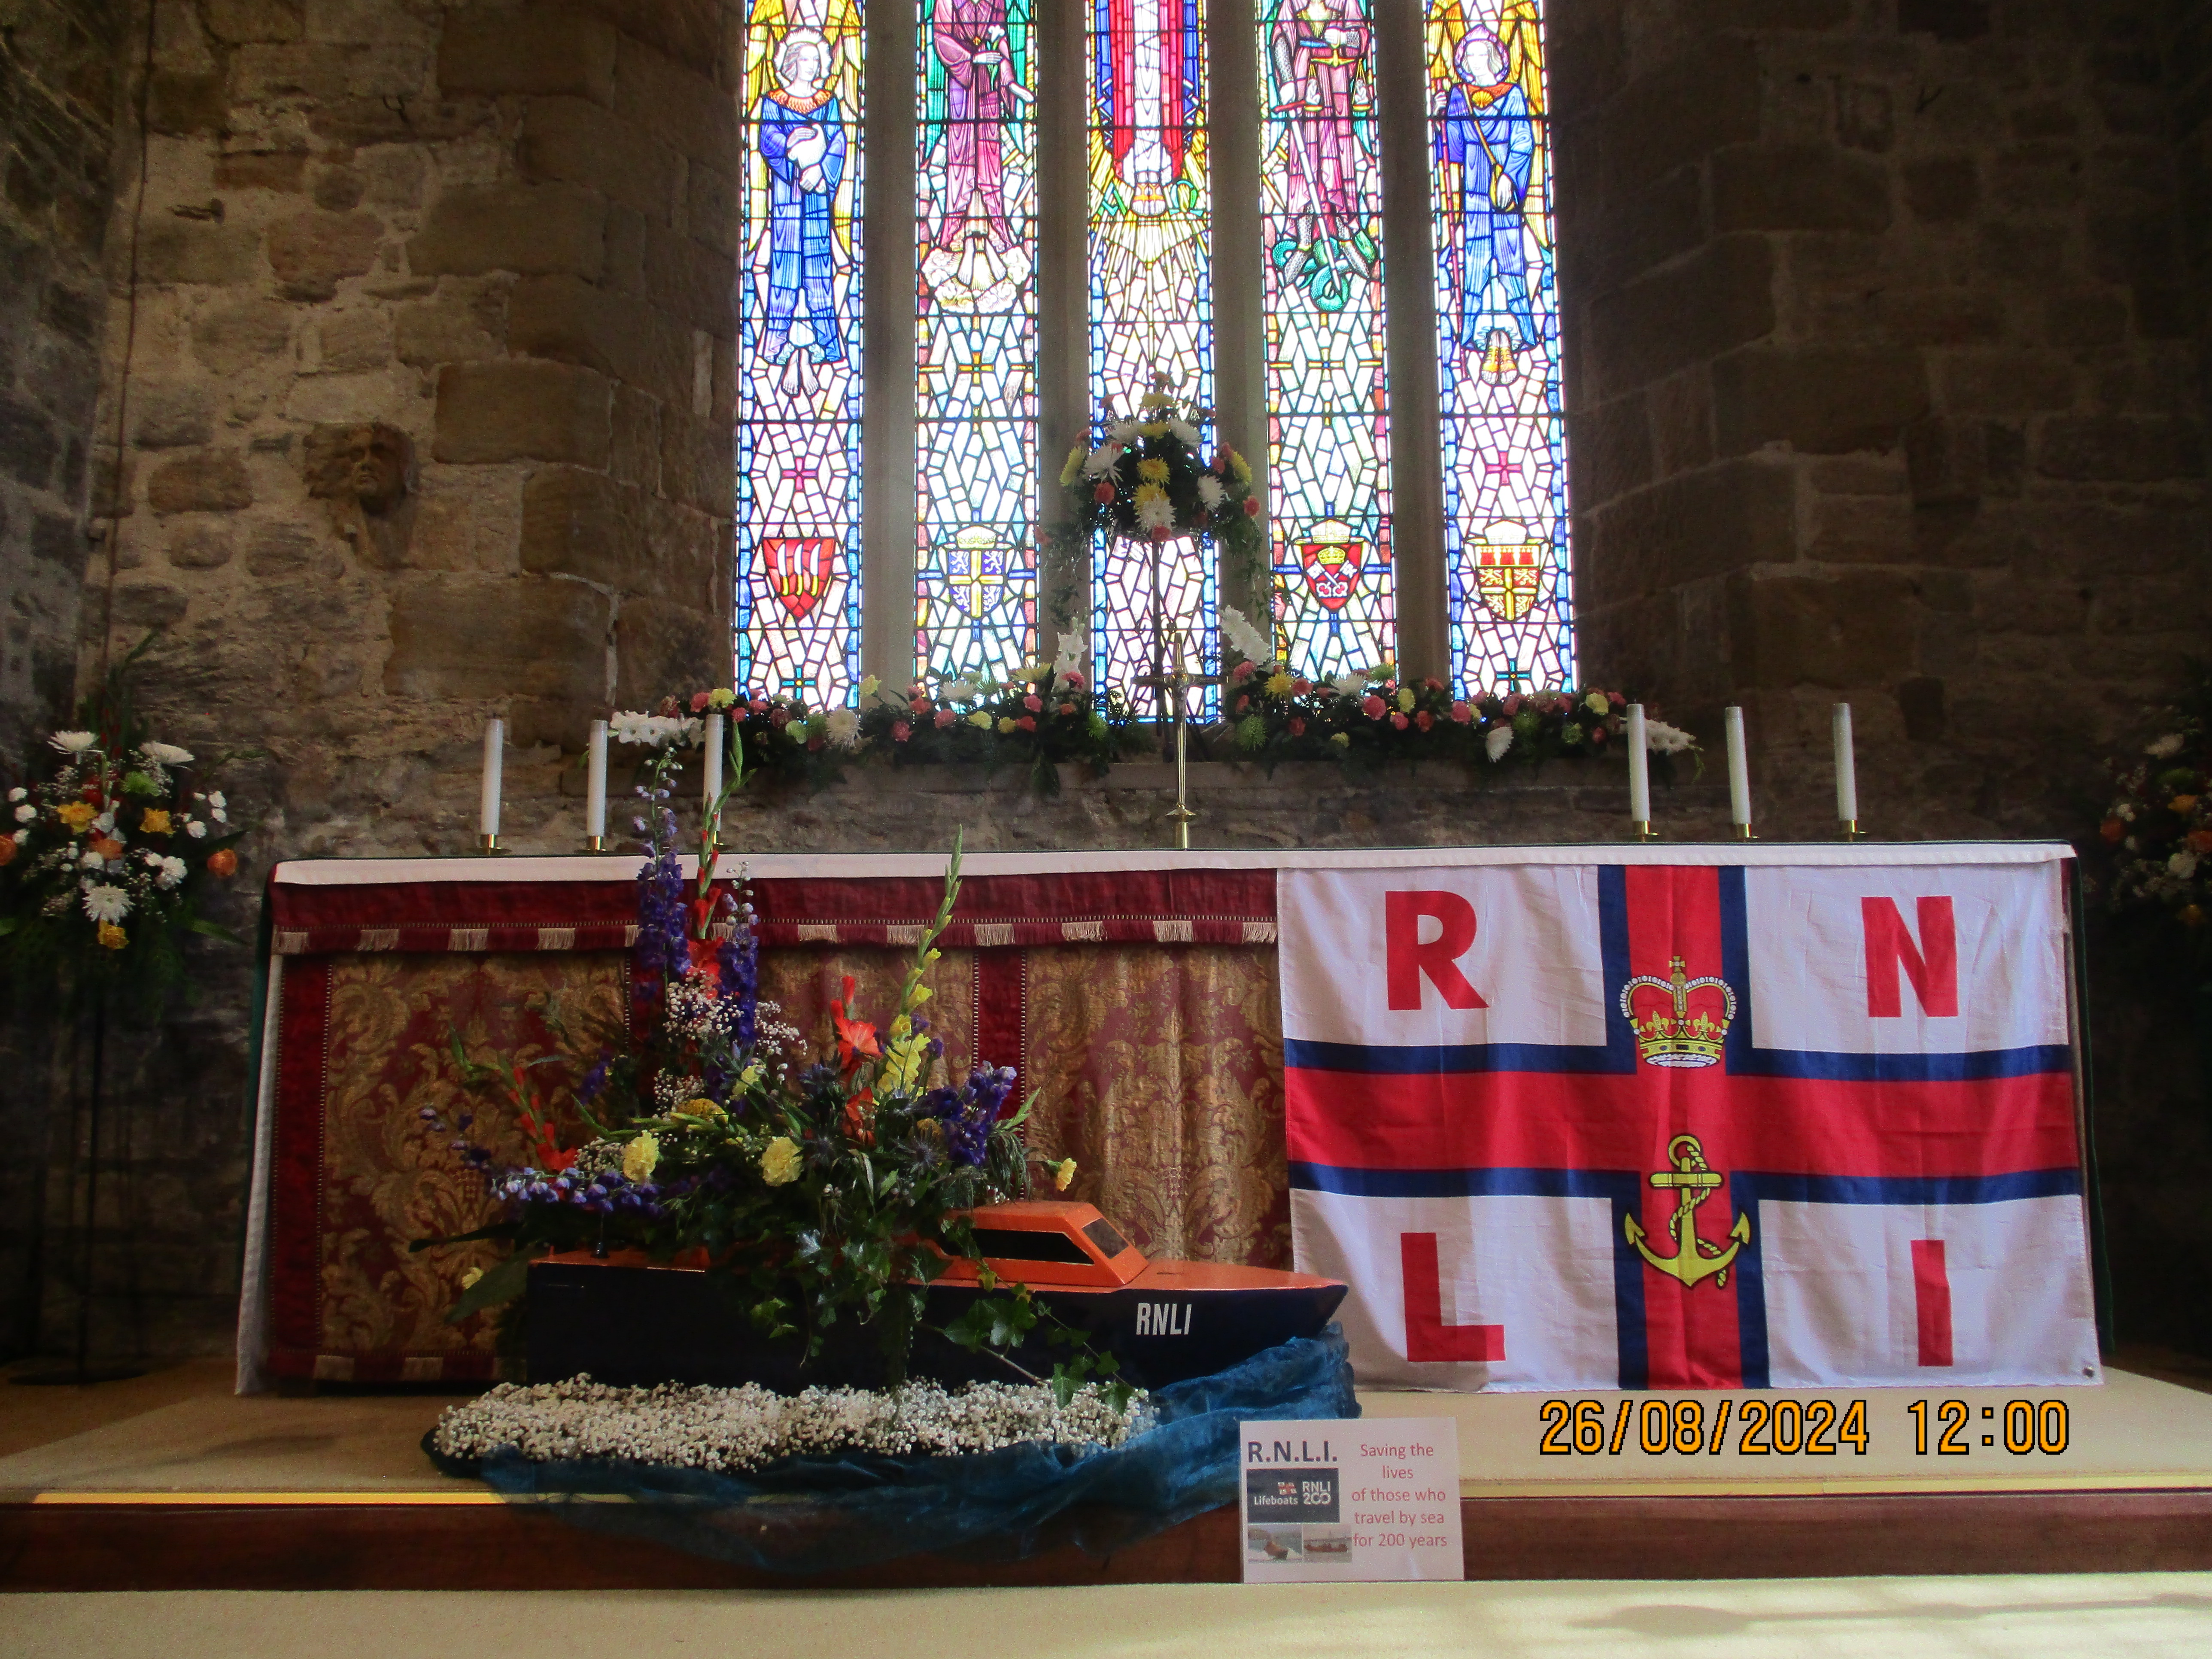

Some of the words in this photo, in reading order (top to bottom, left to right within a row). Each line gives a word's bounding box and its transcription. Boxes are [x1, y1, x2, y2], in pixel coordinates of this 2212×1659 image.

[1385, 890, 1489, 1010] R
[1860, 896, 1958, 1018] N
[1401, 1232, 1506, 1362] L
[1911, 1240, 1952, 1366] I
[1136, 1302, 1192, 1336] RNLI
[1247, 1440, 1338, 1462] R.N.L.I.
[1360, 1443, 1406, 1460] Saving
[1410, 1443, 1434, 1456] the
[1382, 1465, 1414, 1479] lives
[1302, 1481, 1331, 1492] RNLI
[1352, 1487, 1367, 1501] of
[1370, 1487, 1410, 1501] those
[1414, 1487, 1446, 1501] who
[1254, 1495, 1298, 1505] Lifeboats
[1355, 1510, 1395, 1524] travel
[1399, 1510, 1416, 1527] by
[1420, 1513, 1444, 1524] sea
[1353, 1532, 1374, 1547] for
[1379, 1533, 1405, 1547] 200
[1409, 1536, 1447, 1550] years
